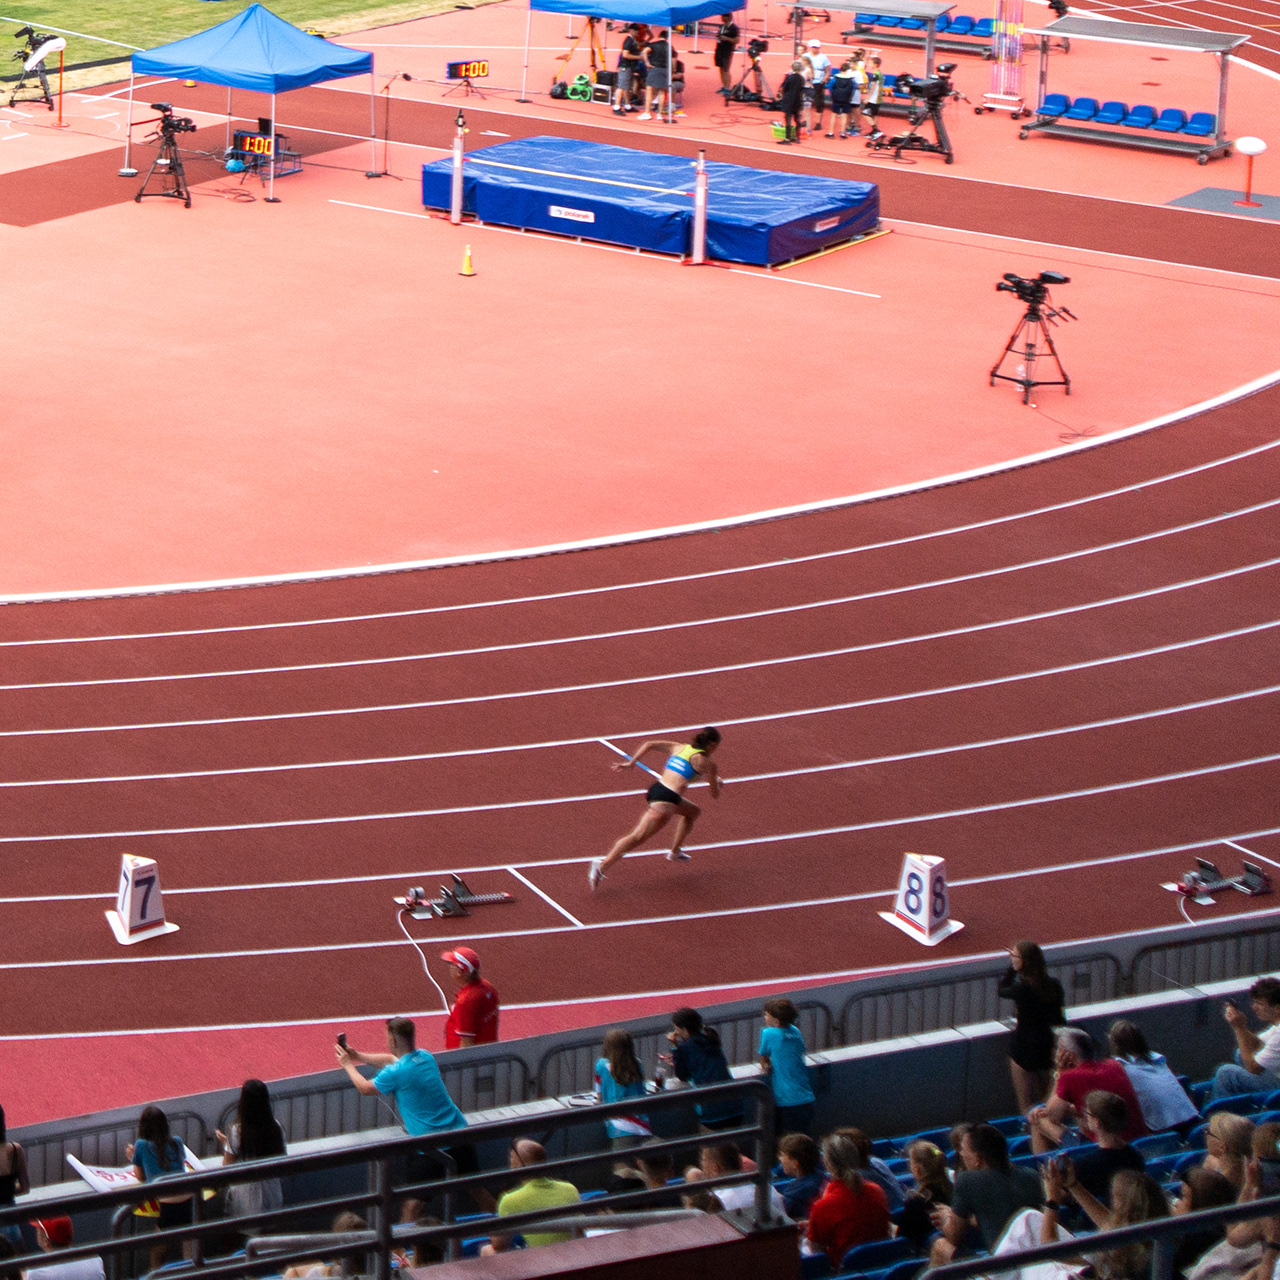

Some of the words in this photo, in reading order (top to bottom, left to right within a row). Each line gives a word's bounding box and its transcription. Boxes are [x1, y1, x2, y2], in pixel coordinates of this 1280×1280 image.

[461, 61, 488, 78] 1:00
[134, 875, 156, 920] 7
[903, 871, 925, 917] 8
[932, 874, 947, 920] 8
